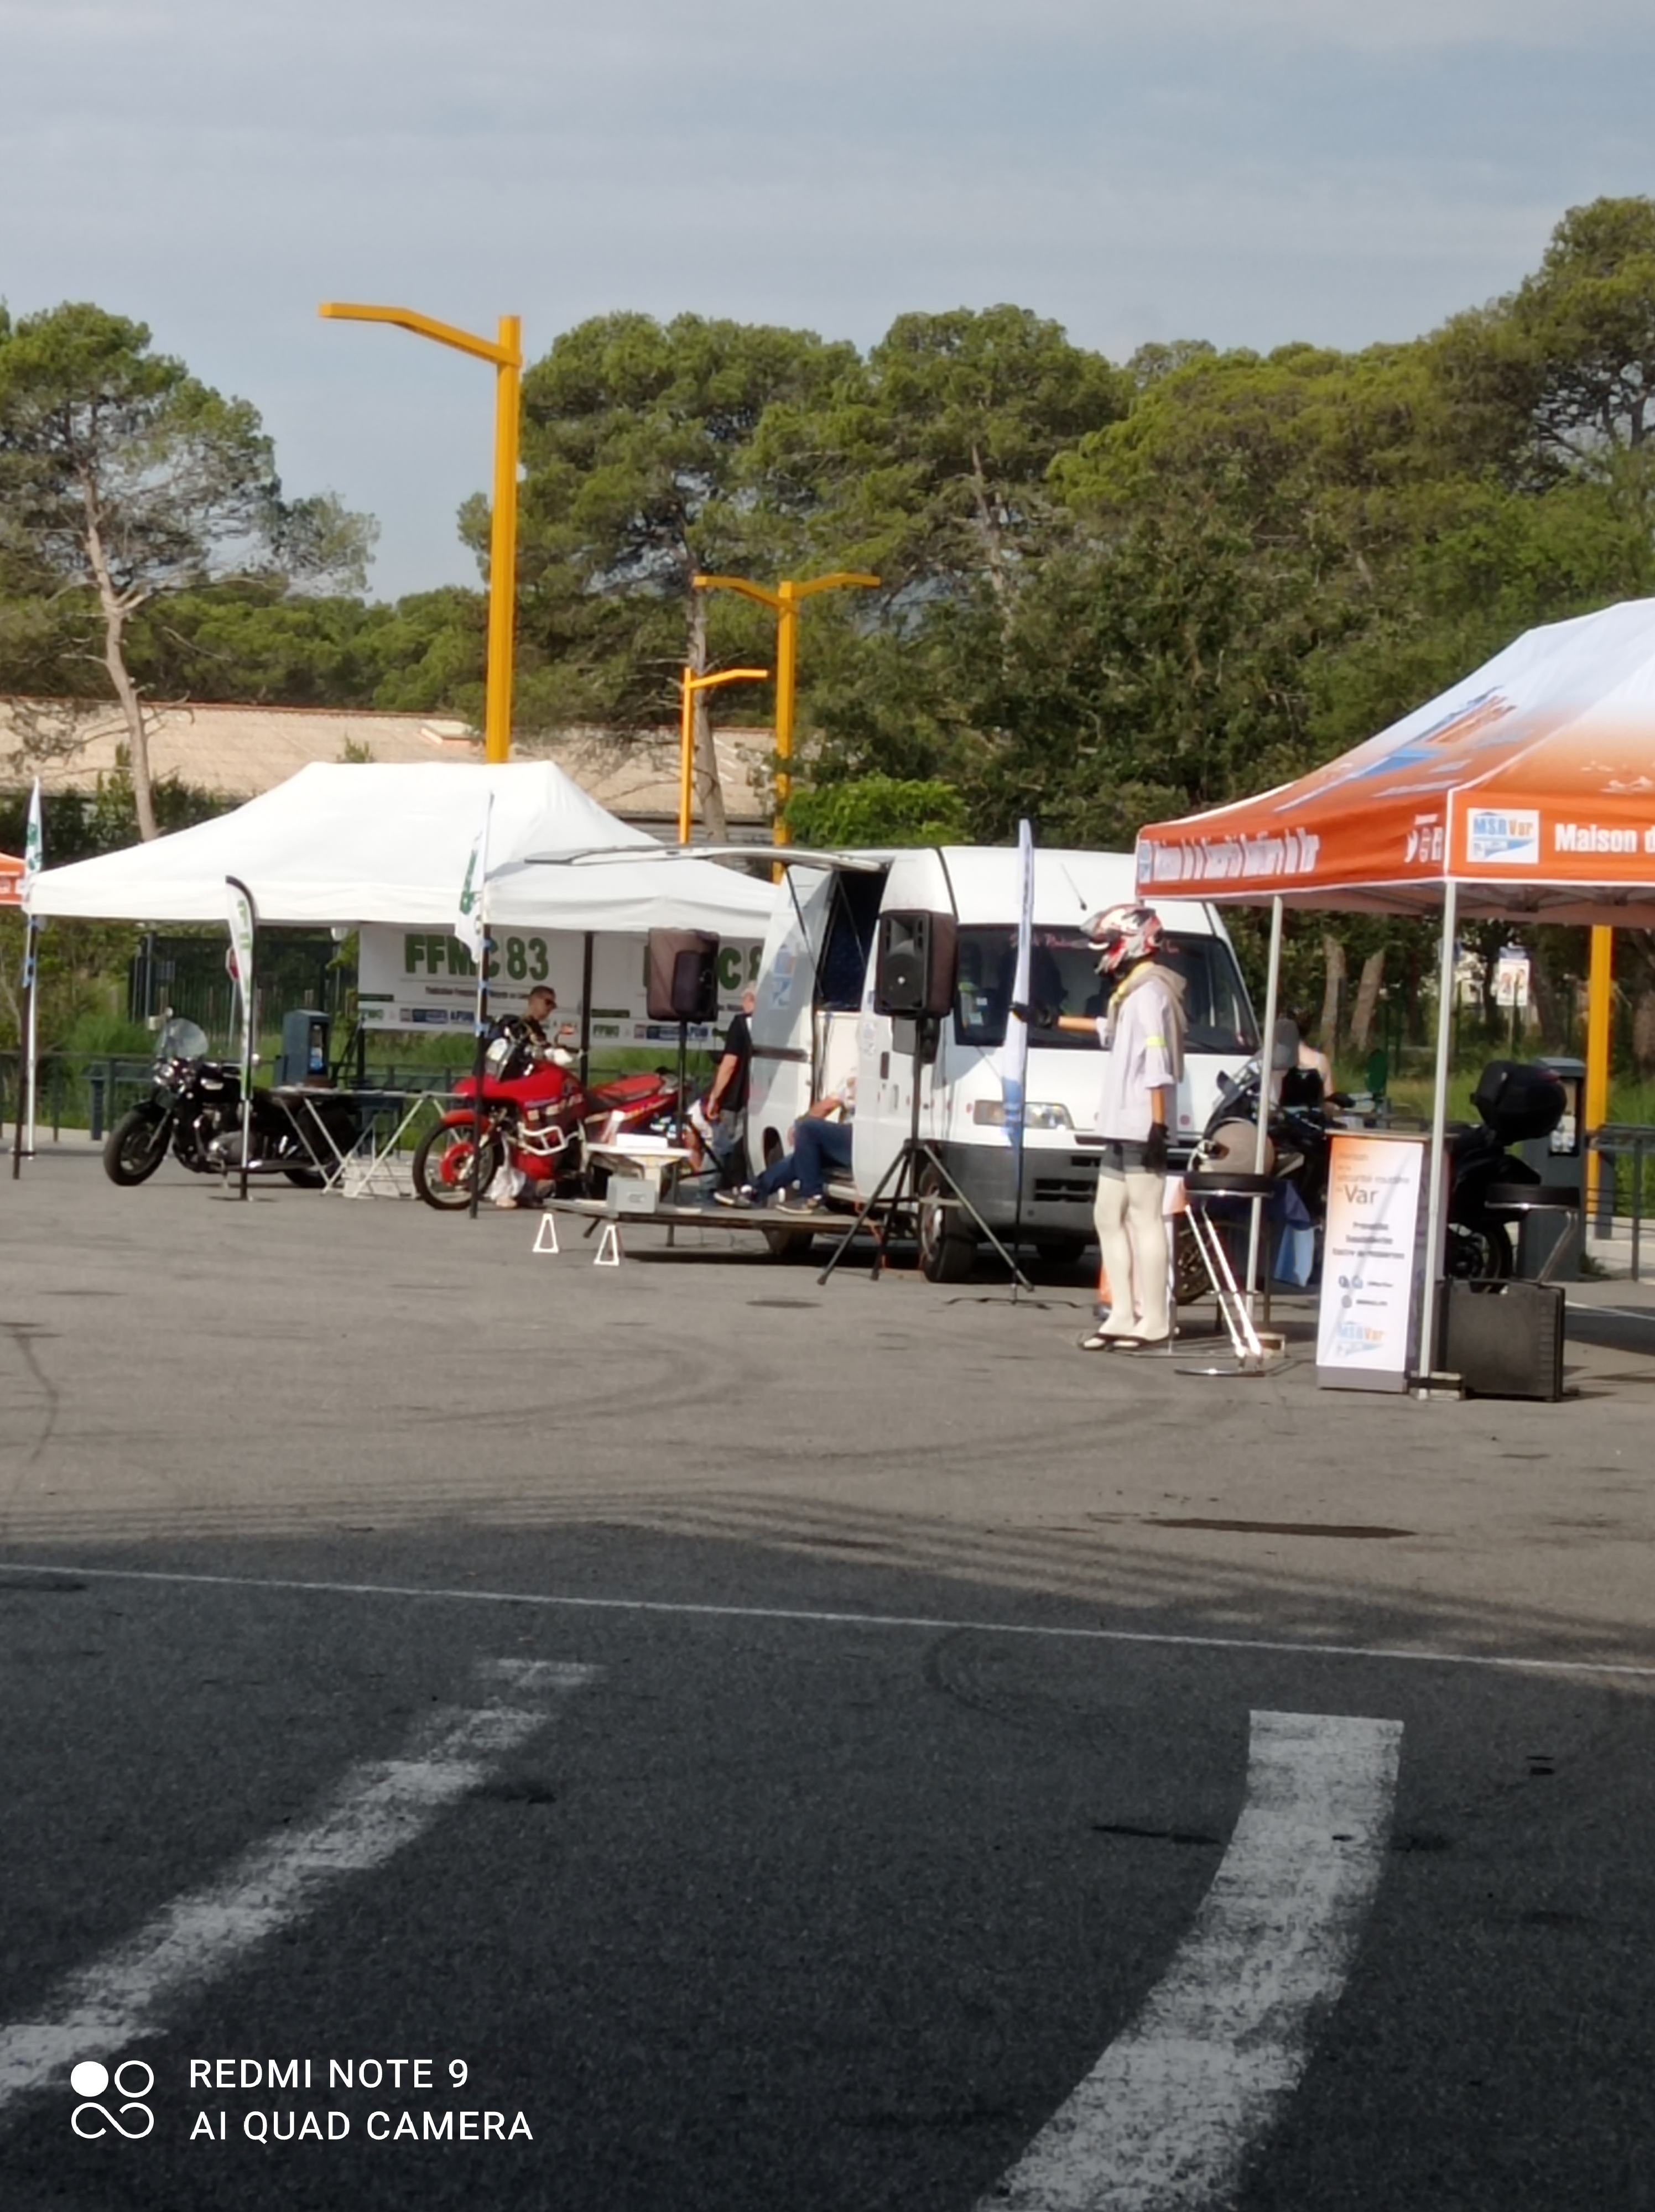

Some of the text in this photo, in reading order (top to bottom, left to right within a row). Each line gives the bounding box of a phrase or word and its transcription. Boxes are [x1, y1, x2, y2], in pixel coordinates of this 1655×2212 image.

[1555, 823, 1637, 853] Maison
[506, 937, 549, 980] 83
[1344, 1183, 1378, 1204] Var
